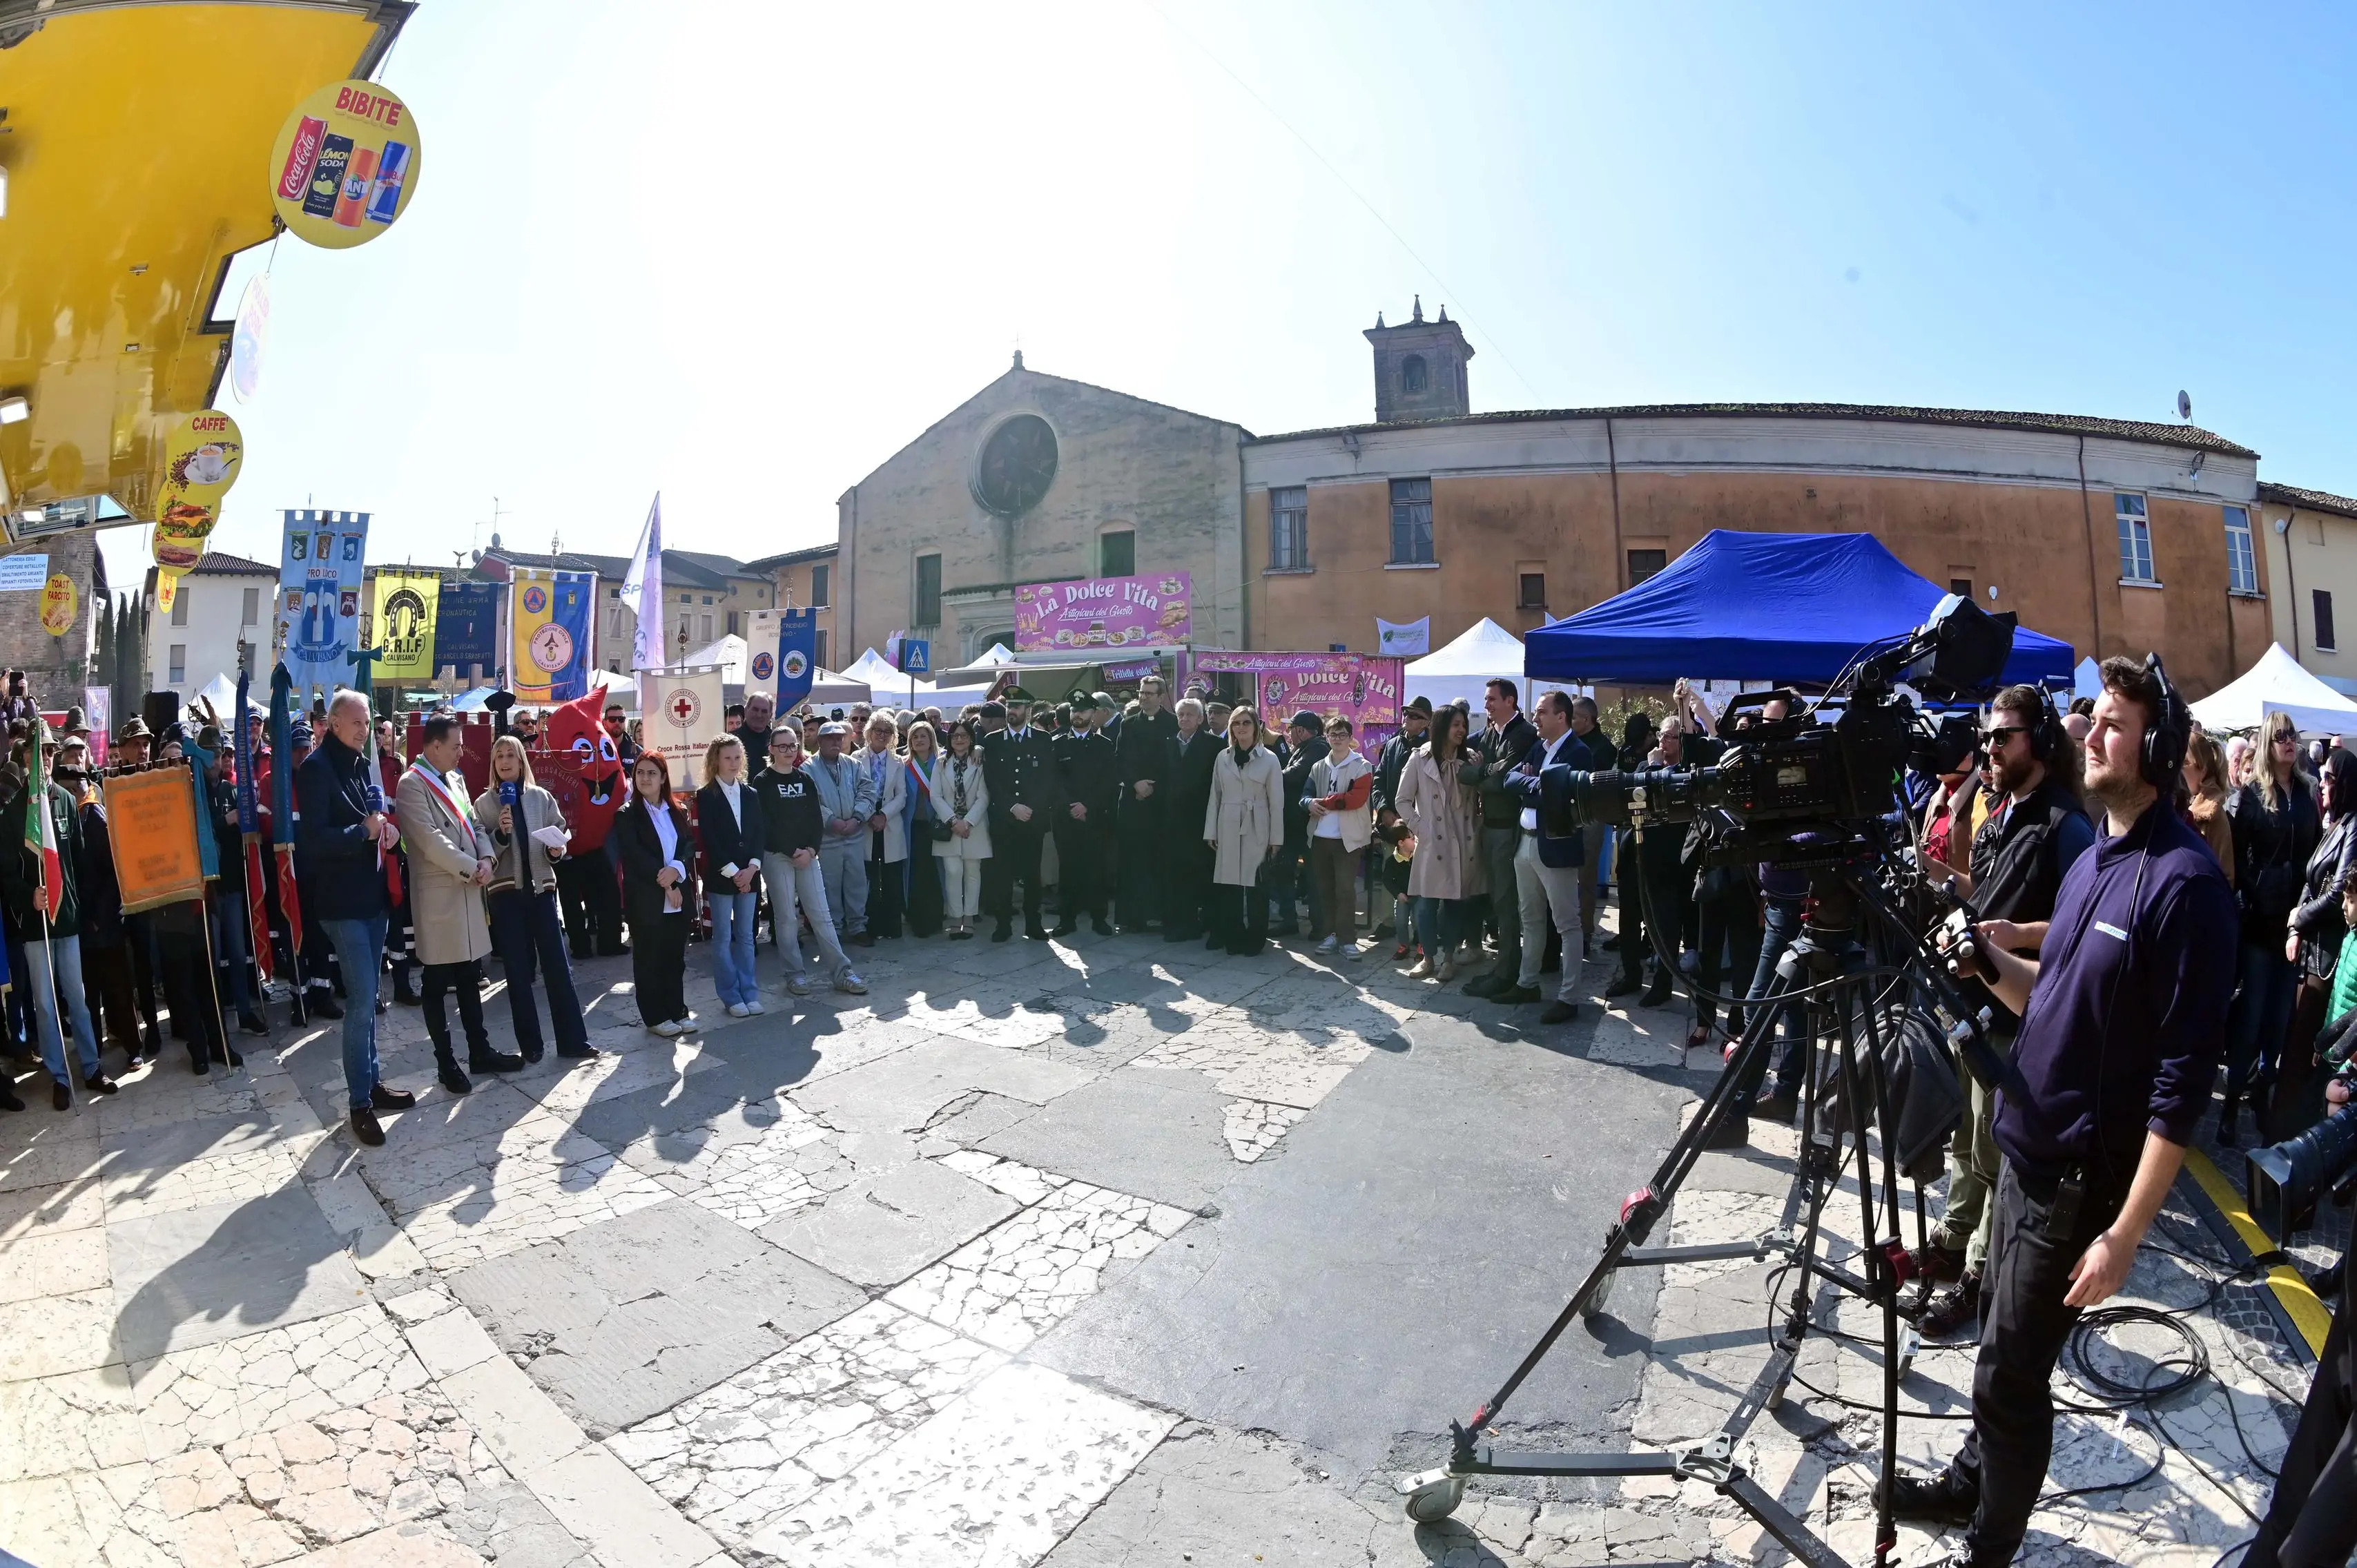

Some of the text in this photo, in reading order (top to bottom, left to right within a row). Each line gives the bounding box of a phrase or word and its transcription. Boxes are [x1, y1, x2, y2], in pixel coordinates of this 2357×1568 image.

[336, 86, 403, 126] BIBITE
[319, 148, 350, 160] LEMON
[307, 568, 321, 578] PRO
[51, 579, 70, 590] TOAST
[47, 590, 70, 601] FARCITO
[1035, 581, 1159, 619] La Dolce Vita
[1058, 605, 1134, 622] Artigiani del Gusto
[534, 626, 569, 645] PROTEZIONE CIVILE
[537, 659, 565, 669] CALVISANO
[1245, 657, 1316, 671] Artigiani del Gusto
[1112, 666, 1153, 680] Frittelle calde
[1297, 672, 1350, 688] Dolce
[1288, 691, 1328, 705] Artigiani
[1328, 692, 1341, 702] del
[1379, 733, 1395, 744] Do
[535, 766, 579, 788] BERSAGLIERI
[777, 783, 803, 795] EA7
